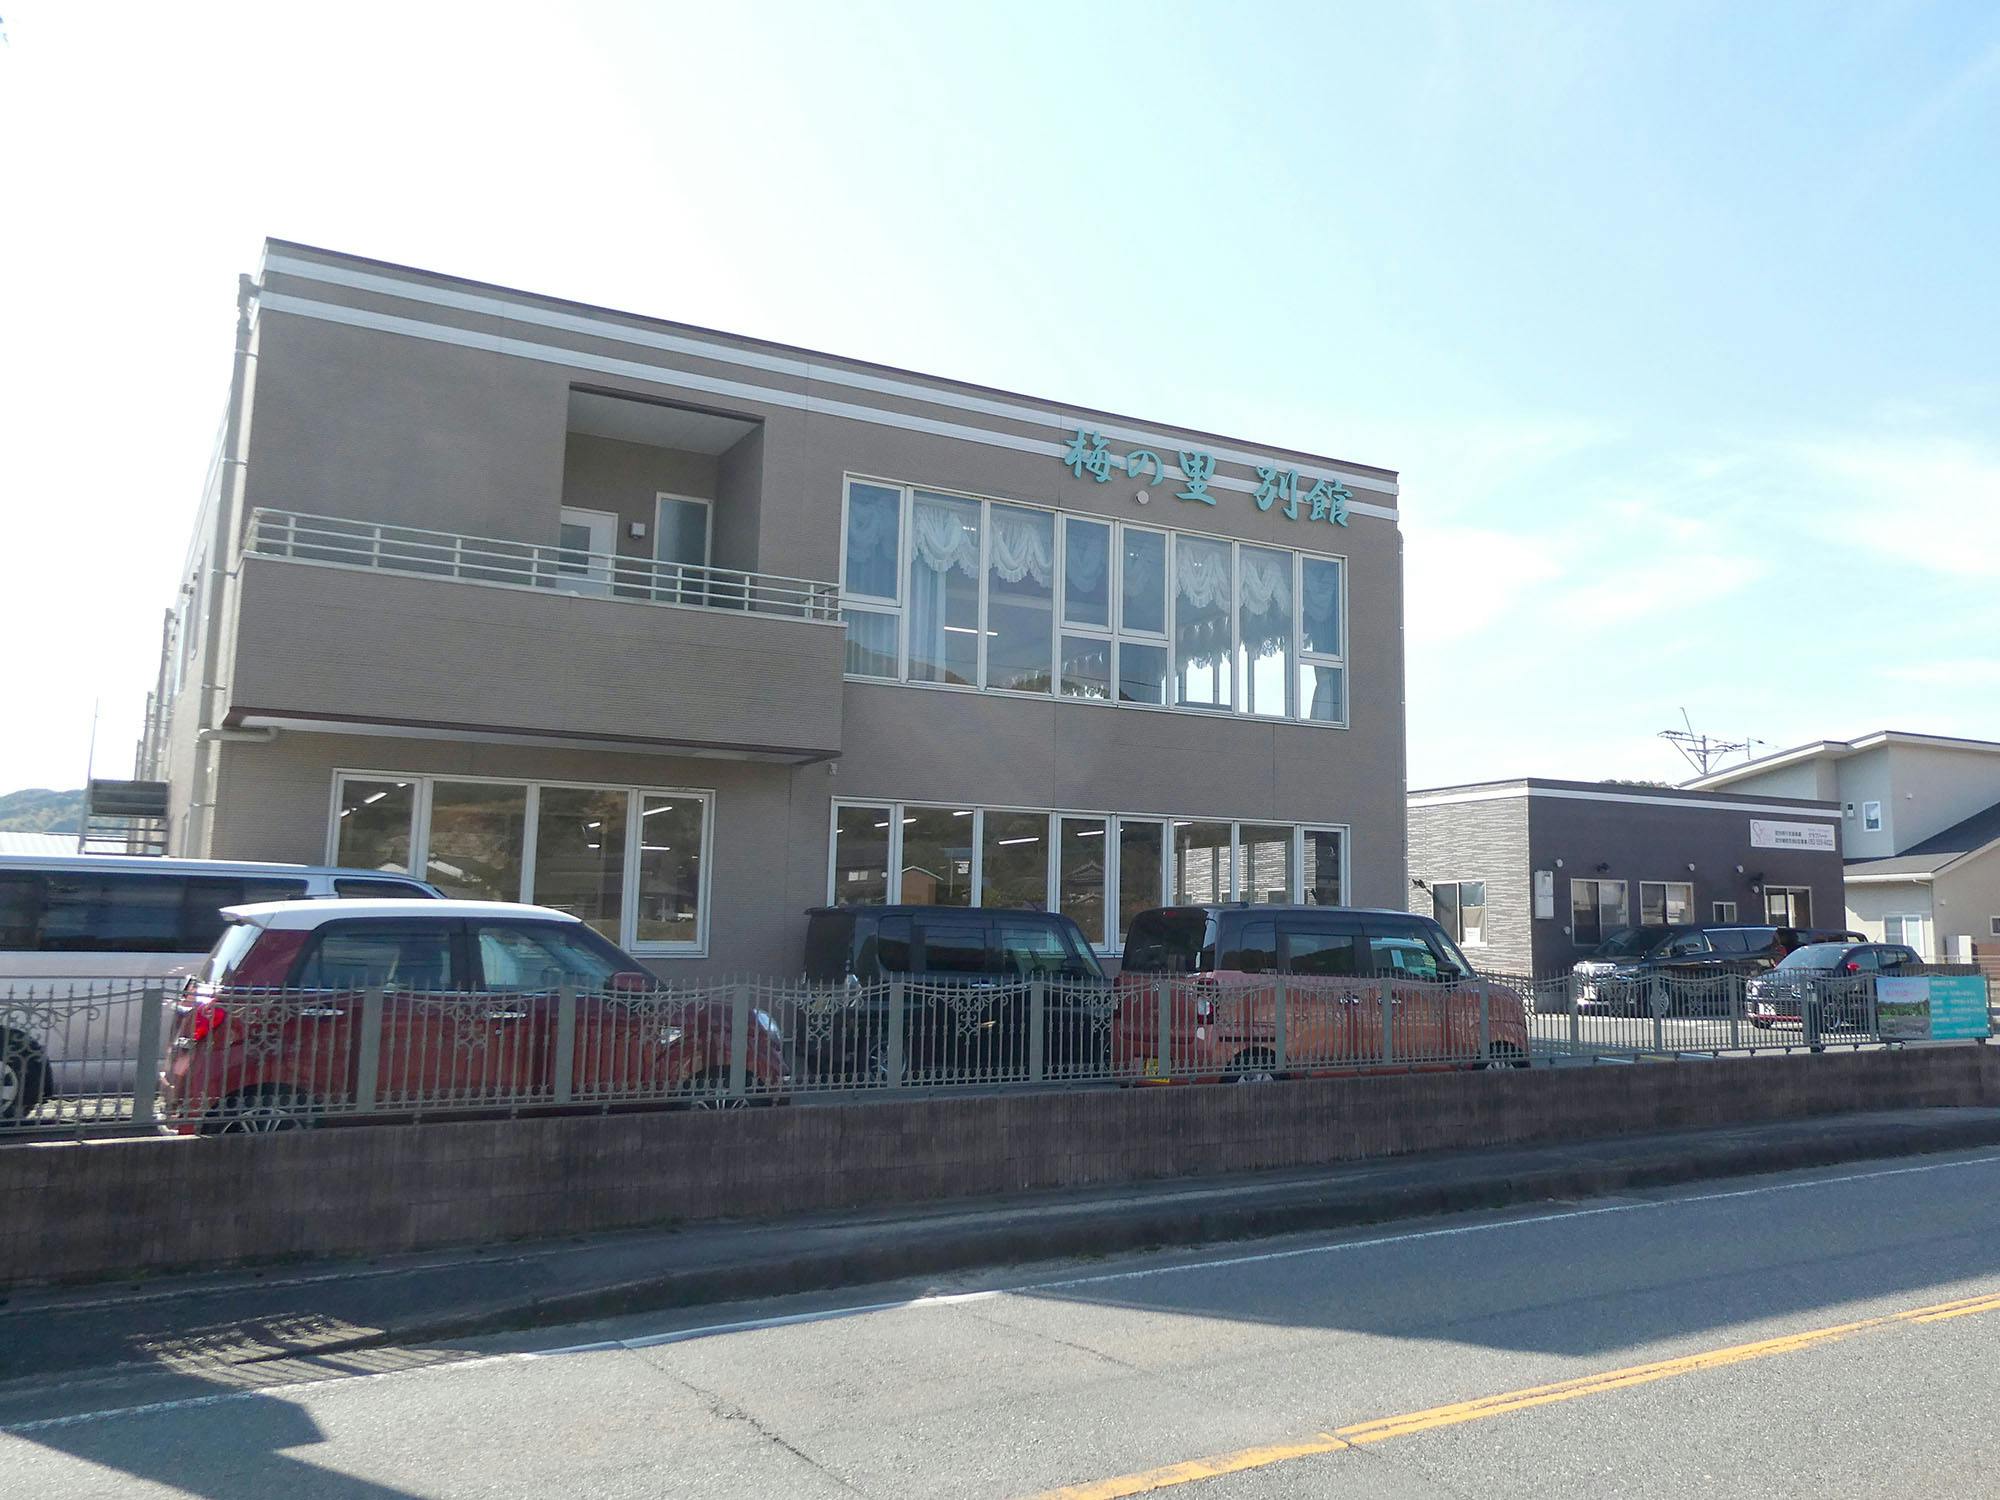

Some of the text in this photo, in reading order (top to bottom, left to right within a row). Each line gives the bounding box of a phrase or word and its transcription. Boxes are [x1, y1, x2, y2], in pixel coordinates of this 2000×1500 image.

[1064, 427, 1353, 528] 梅の里 別館
